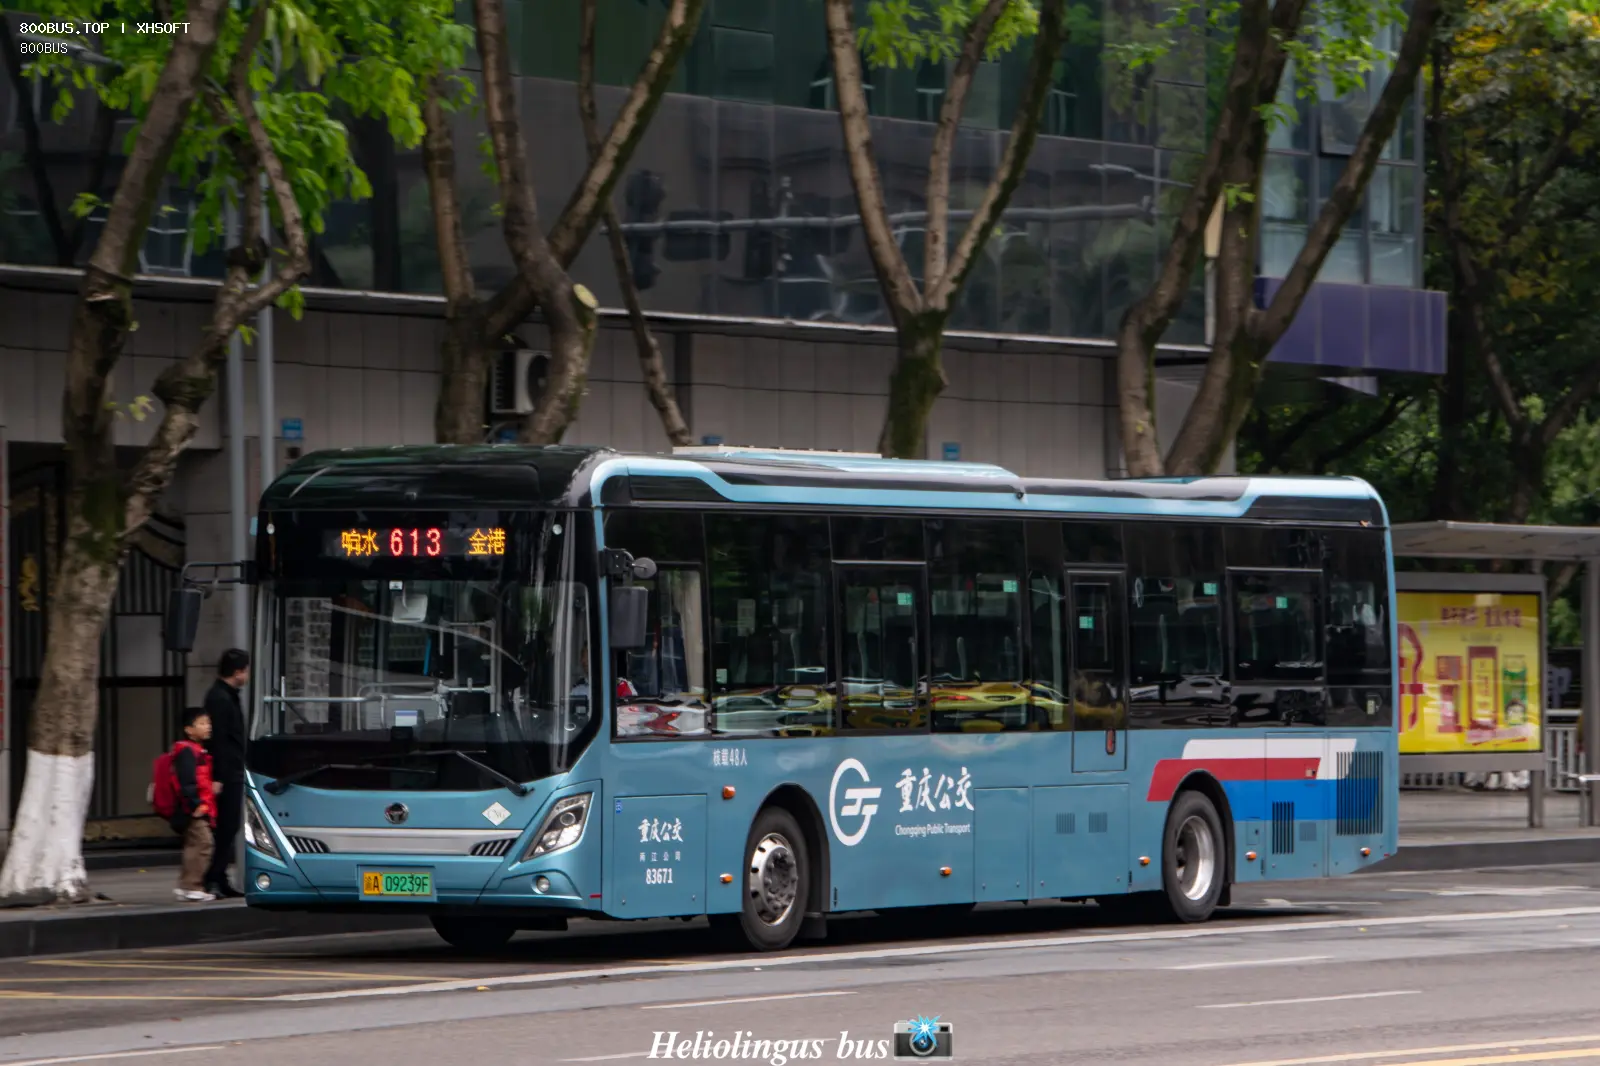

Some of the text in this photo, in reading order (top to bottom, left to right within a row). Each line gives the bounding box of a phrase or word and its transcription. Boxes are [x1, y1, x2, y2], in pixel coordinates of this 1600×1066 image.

[341, 527, 506, 556] 响水 613 金港
[895, 766, 975, 813] 重庆公交
[638, 818, 683, 843] 重庆公交
[895, 823, 971, 838] Chongqing Public Transport
[645, 868, 673, 885] 83671
